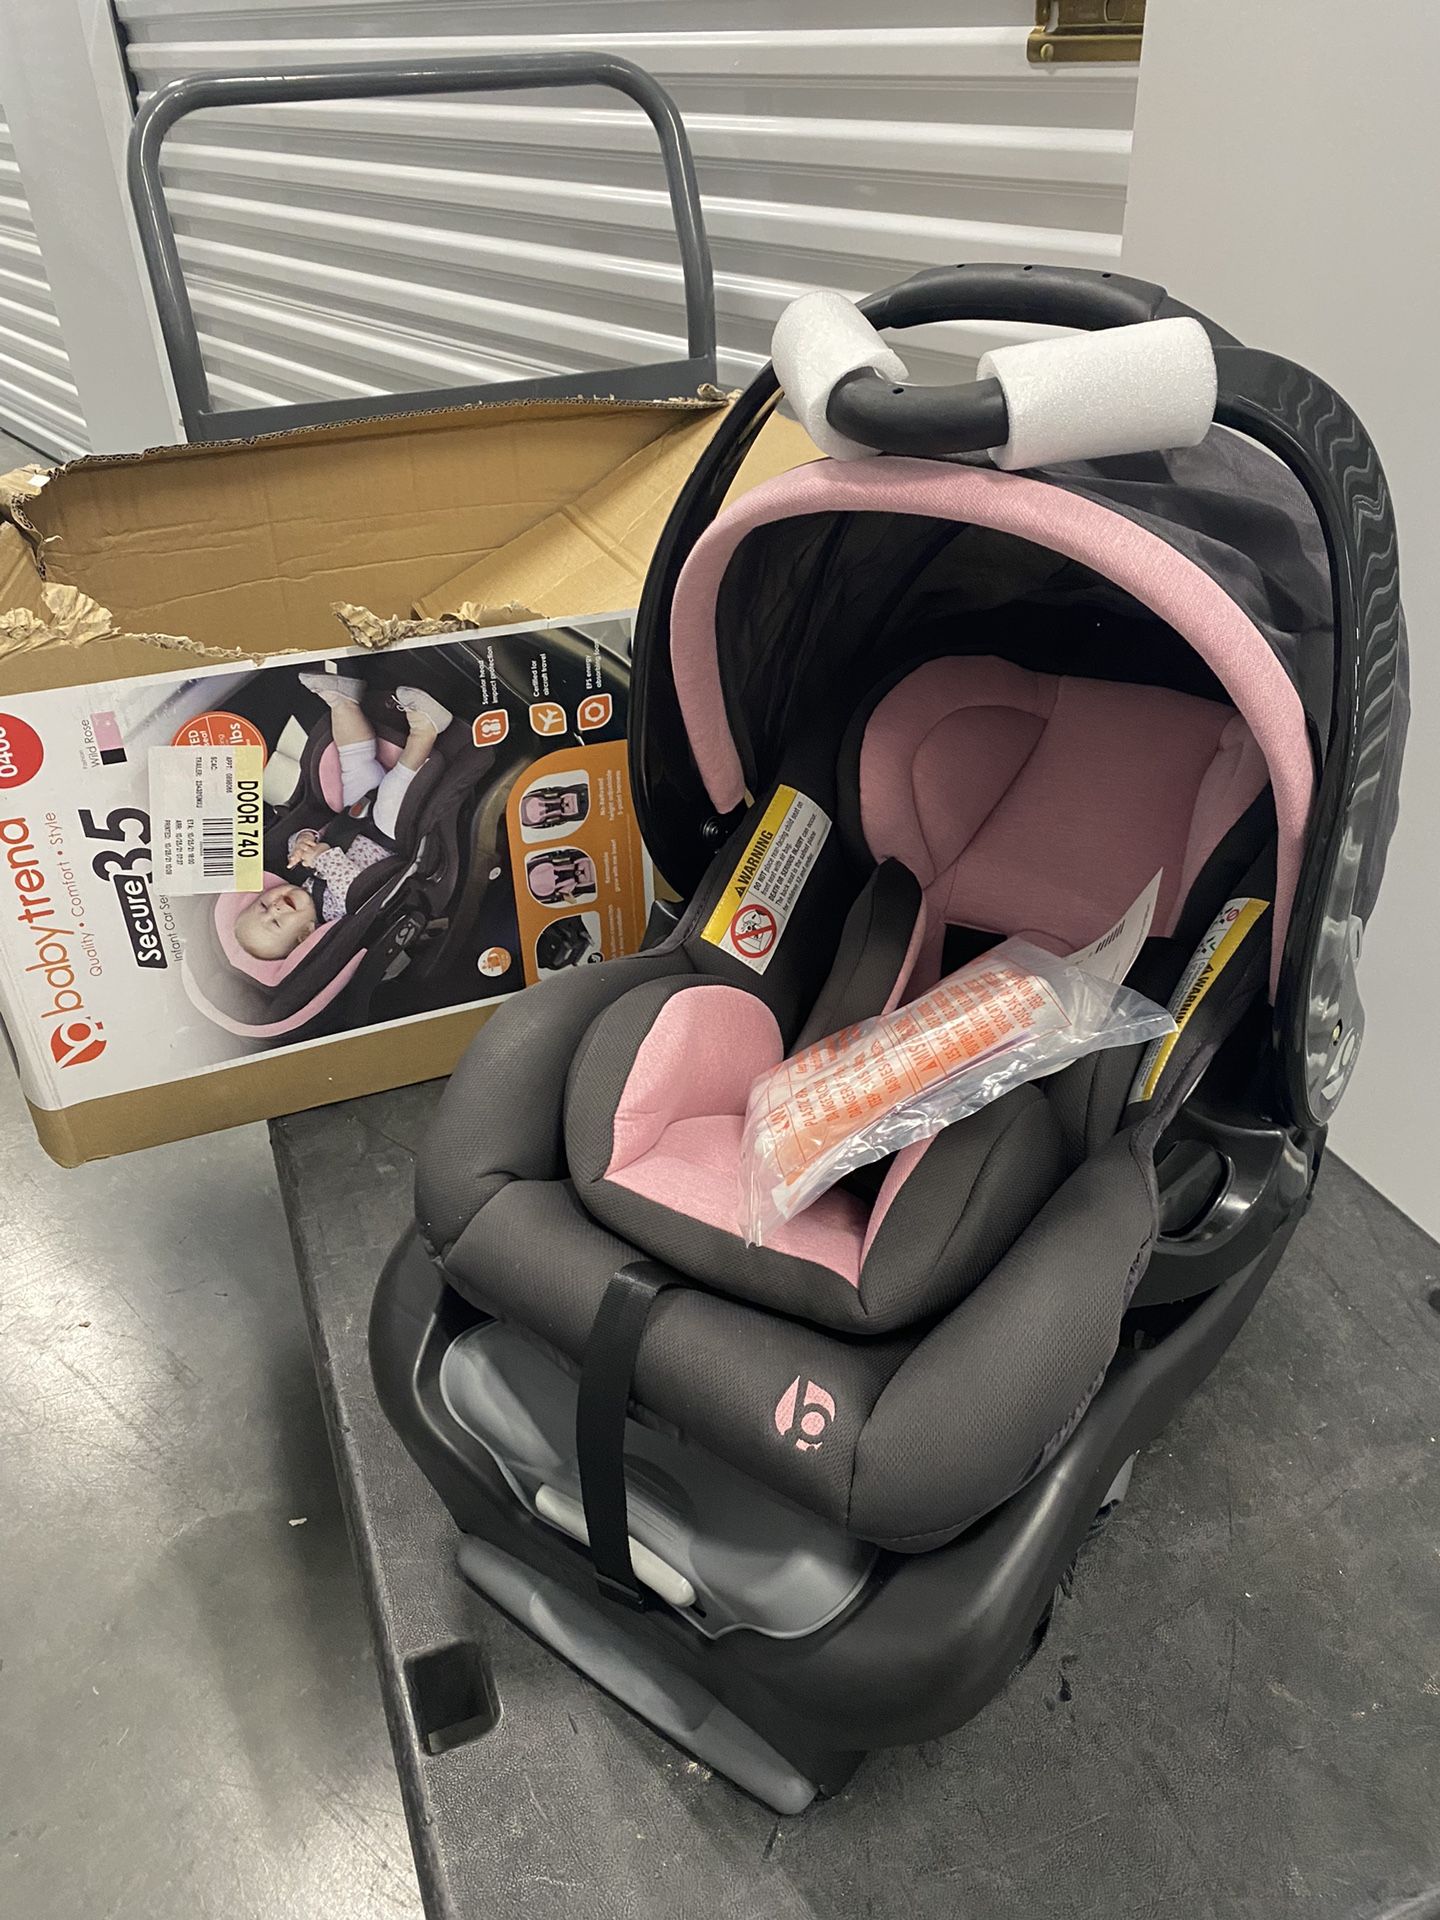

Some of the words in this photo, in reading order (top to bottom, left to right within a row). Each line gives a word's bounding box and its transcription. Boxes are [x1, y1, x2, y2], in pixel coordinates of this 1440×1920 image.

[487, 646, 495, 680] protection
[541, 673, 549, 696] aircraft
[80, 719, 92, 743] Rose
[230, 723, 242, 744] lbs
[86, 744, 100, 768] Wild
[236, 781, 259, 824] DOOR
[42, 811, 63, 845] Style
[805, 830, 817, 845] place
[78, 807, 152, 883] 35
[237, 829, 259, 858] 740
[738, 830, 773, 886] WARNING
[752, 881, 761, 890] DO
[757, 870, 767, 882] NOT
[762, 856, 775, 873] place
[769, 830, 789, 859] rear-facing
[783, 818, 794, 832] child
[790, 806, 800, 819] seat
[797, 843, 810, 860] safest
[760, 882, 771, 896] front
[766, 870, 777, 883] seat
[772, 859, 783, 872] with
[767, 883, 781, 901] DEATH
[779, 853, 795, 877] SERIOUS
[790, 835, 804, 856] INJURY
[800, 826, 810, 838] can
[793, 858, 802, 868] the
[56, 861, 85, 917] Comfort
[779, 883, 789, 896] back
[784, 883, 799, 904] children
[797, 866, 807, 878] and
[786, 872, 795, 884] seat
[158, 894, 170, 909] Se
[774, 895, 784, 906] The
[0, 817, 81, 1019] babytrend
[124, 878, 161, 962] Secure
[162, 911, 176, 931] Car
[81, 930, 102, 977] Quality
[168, 933, 184, 962] Infant
[1177, 976, 1209, 1023] WARNIN
[797, 1098, 816, 1127] PLASTIC
